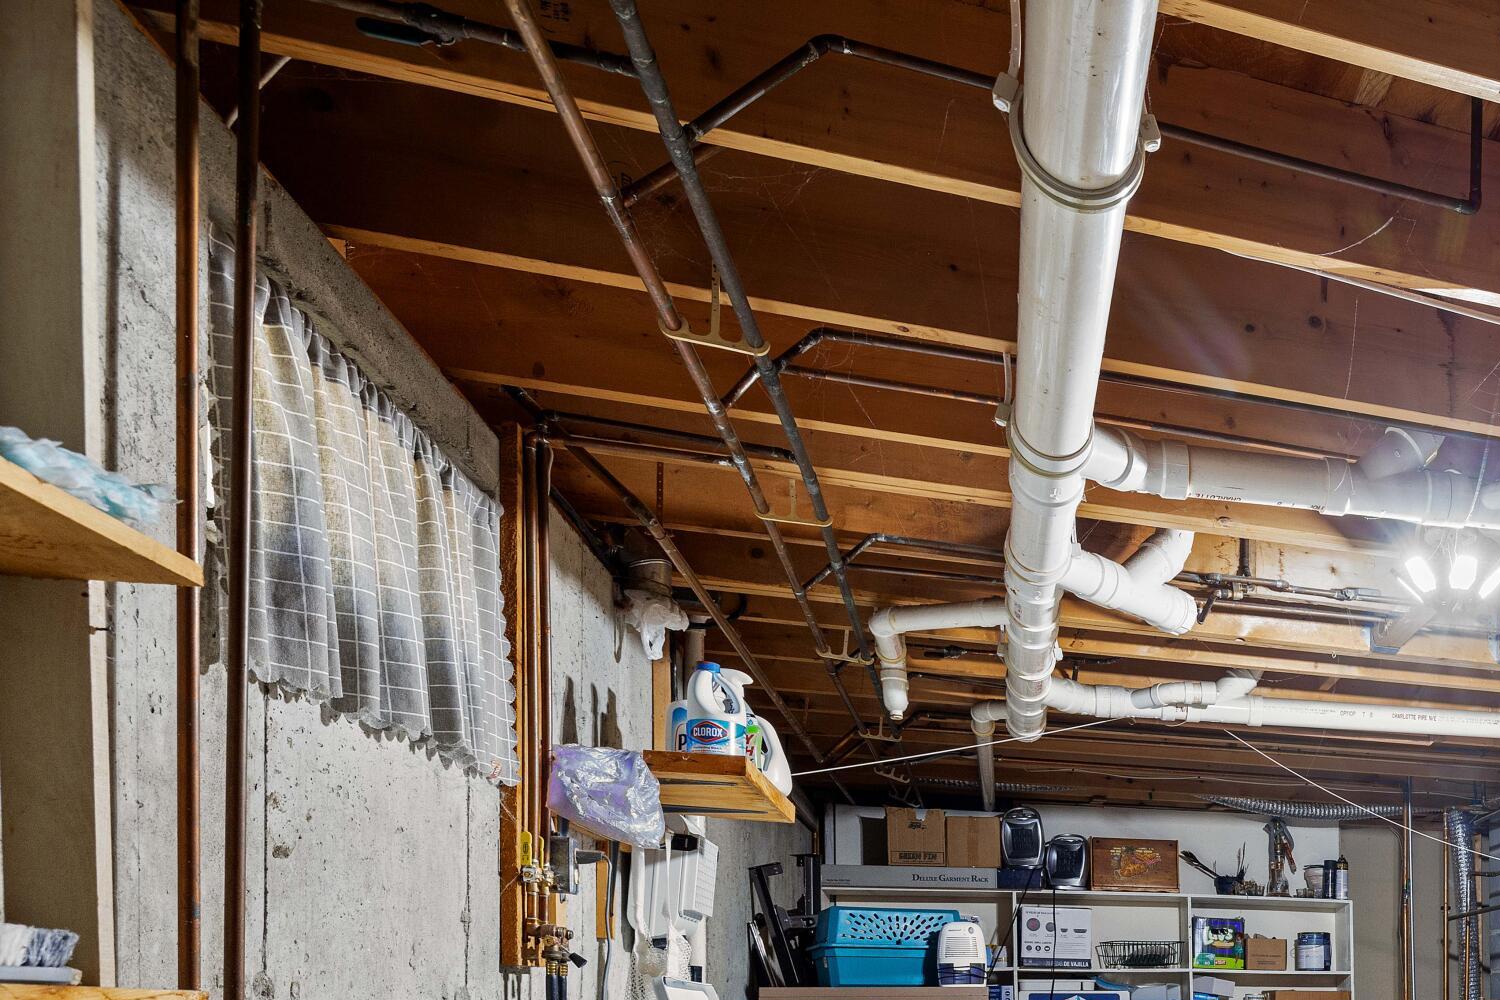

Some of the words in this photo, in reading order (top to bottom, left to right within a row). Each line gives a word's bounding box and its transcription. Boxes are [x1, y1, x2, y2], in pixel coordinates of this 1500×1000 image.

[693, 727, 723, 738] CLOROX
[938, 874, 970, 882] GARMENT
[971, 875, 989, 883] RACK
